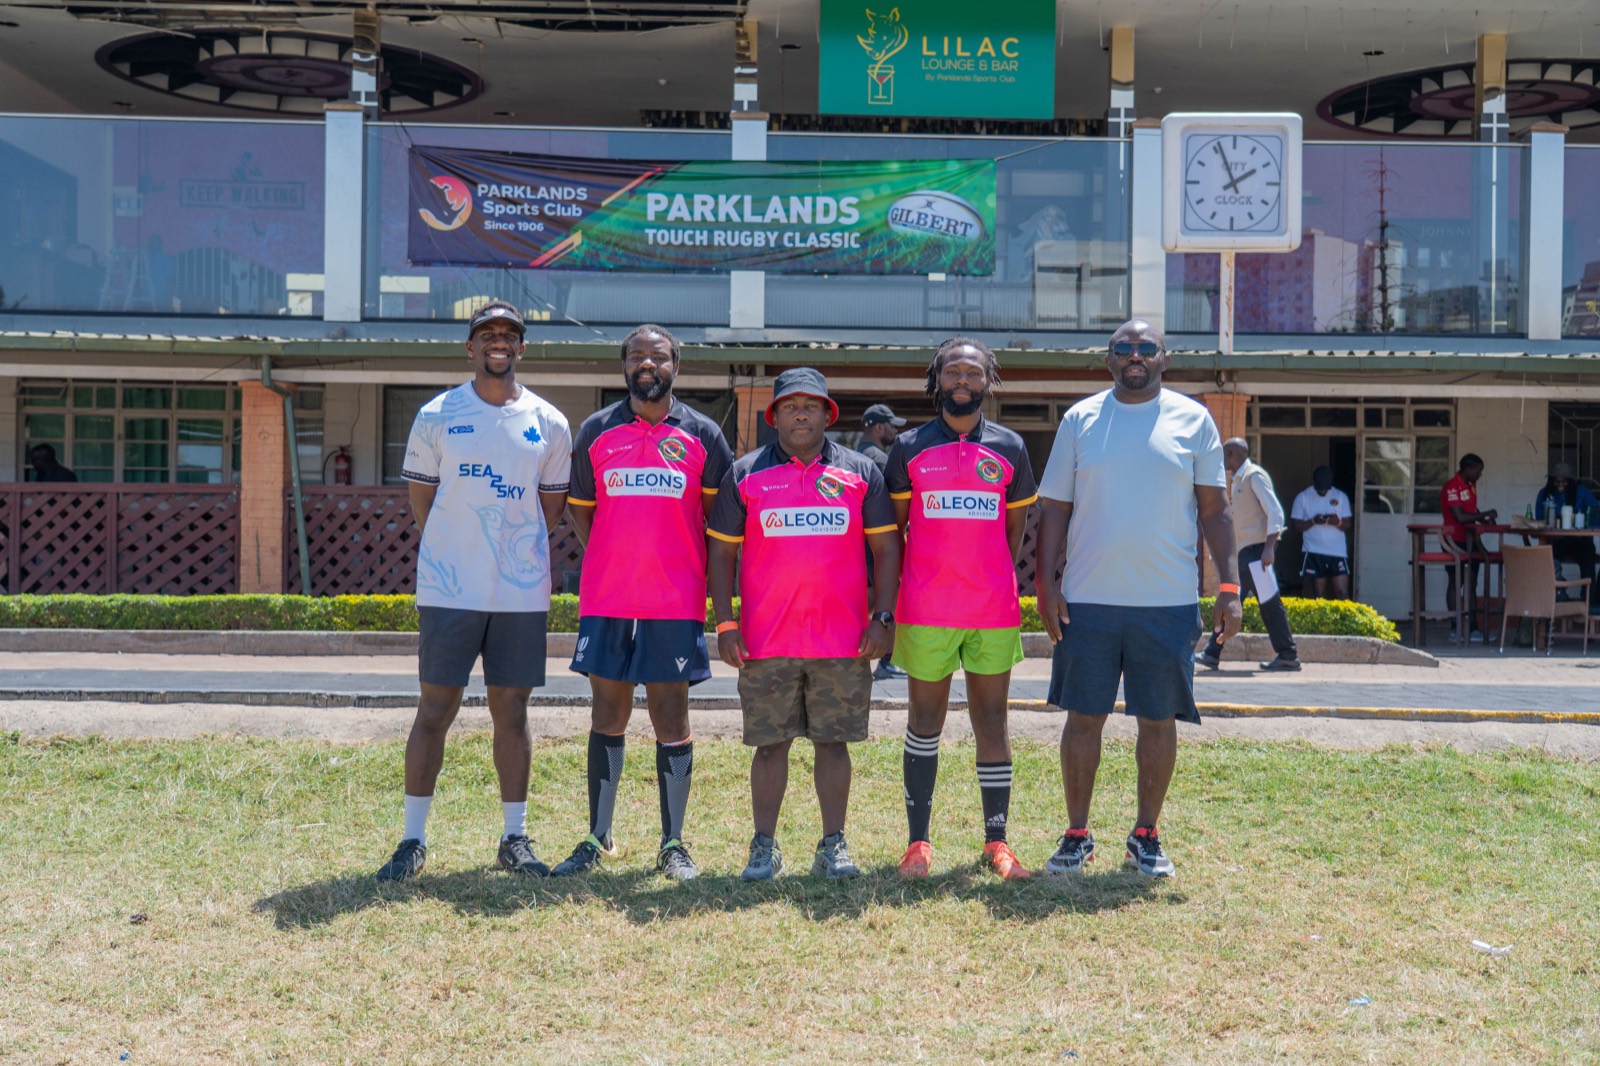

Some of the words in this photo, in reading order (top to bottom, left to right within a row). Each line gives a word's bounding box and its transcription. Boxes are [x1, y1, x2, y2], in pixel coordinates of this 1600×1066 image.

[922, 36, 1020, 57] LILAC
[921, 58, 974, 71] LOUNGE
[979, 59, 988, 71] &
[991, 60, 1018, 72] BAR
[937, 74, 971, 82] Parklands
[973, 75, 996, 83] Sports
[187, 185, 223, 202] KEEP
[231, 186, 298, 204] WALKING
[477, 183, 588, 201] PARKLANDS
[1214, 195, 1253, 206] CLOCK
[483, 201, 540, 218] Sports
[543, 203, 583, 217] Club
[646, 193, 860, 225] PARKLANDS
[484, 220, 516, 231] Since
[517, 221, 544, 232] 1906
[890, 207, 973, 237] GILBERT
[645, 228, 709, 246] TOUCH
[713, 230, 778, 247] RUGBY
[783, 232, 861, 249] CLASSIC
[459, 463, 493, 478] SEA
[497, 484, 526, 500] SKY
[625, 473, 683, 490] LEONS
[942, 495, 997, 512] LEONS
[784, 512, 846, 528] LEONS
